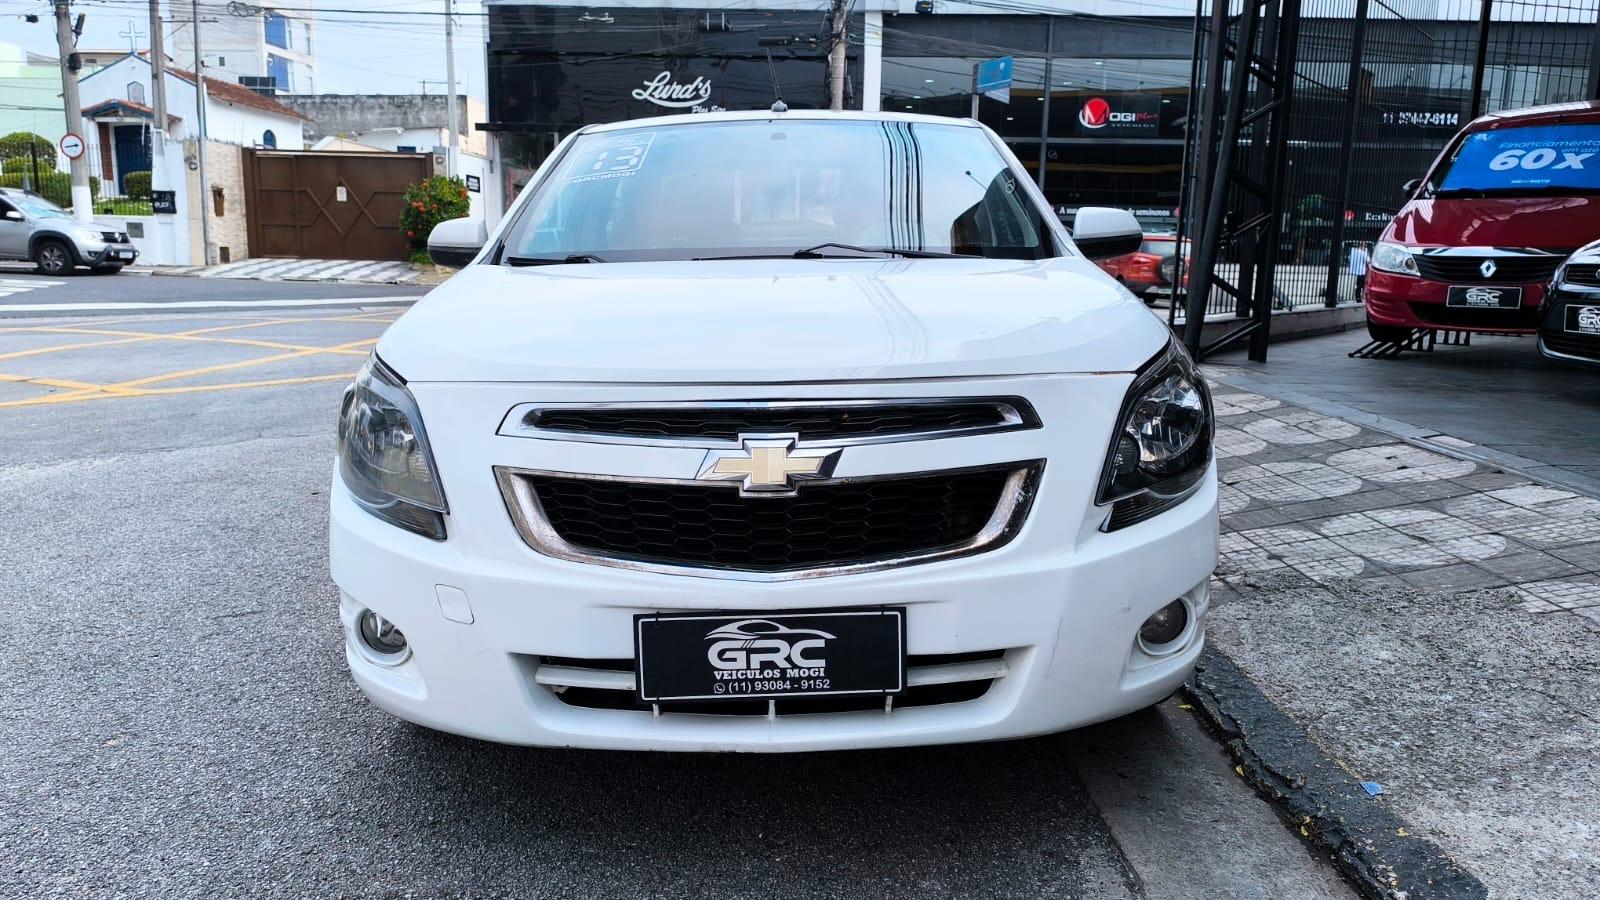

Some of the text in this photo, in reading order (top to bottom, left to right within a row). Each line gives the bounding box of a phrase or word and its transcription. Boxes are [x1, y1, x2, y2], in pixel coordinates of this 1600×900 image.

[632, 71, 711, 108] Lurd's
[1499, 139, 1600, 149] Financiamento
[1466, 292, 1500, 303] GRC
[707, 638, 826, 670] GRC
[713, 667, 825, 680] VEICULOS MOGI
[728, 681, 752, 693] (11)
[754, 679, 791, 691] 93084
[801, 679, 830, 689] 9152
